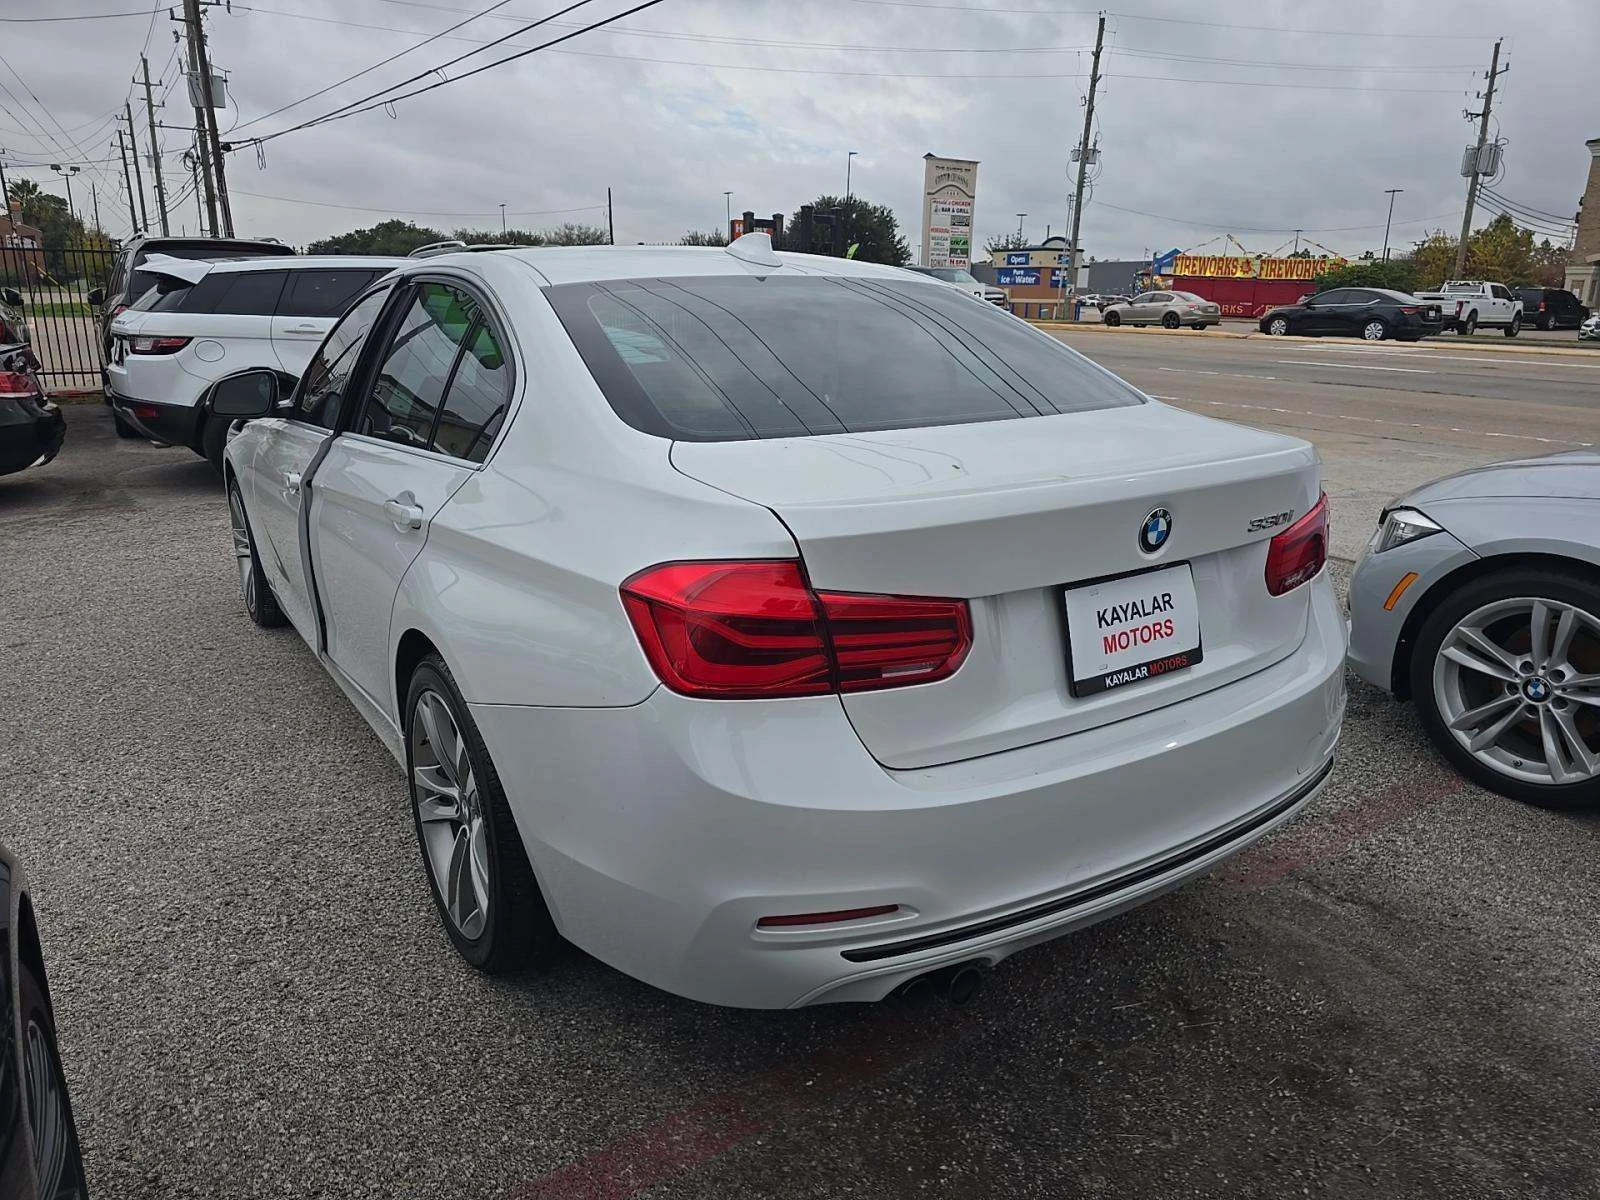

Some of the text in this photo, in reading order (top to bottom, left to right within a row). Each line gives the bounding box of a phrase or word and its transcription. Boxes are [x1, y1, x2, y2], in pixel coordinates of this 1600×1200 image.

[1010, 255, 1026, 264] Open
[1173, 255, 1238, 277] FIREWORKS
[1258, 258, 1327, 279] FIREWORKS
[1000, 275, 1035, 284] Ice Water
[1097, 592, 1174, 628] KAYALAR
[1103, 619, 1174, 655] MOTORS
[1105, 655, 1189, 688] KAYALAR MOTORS
